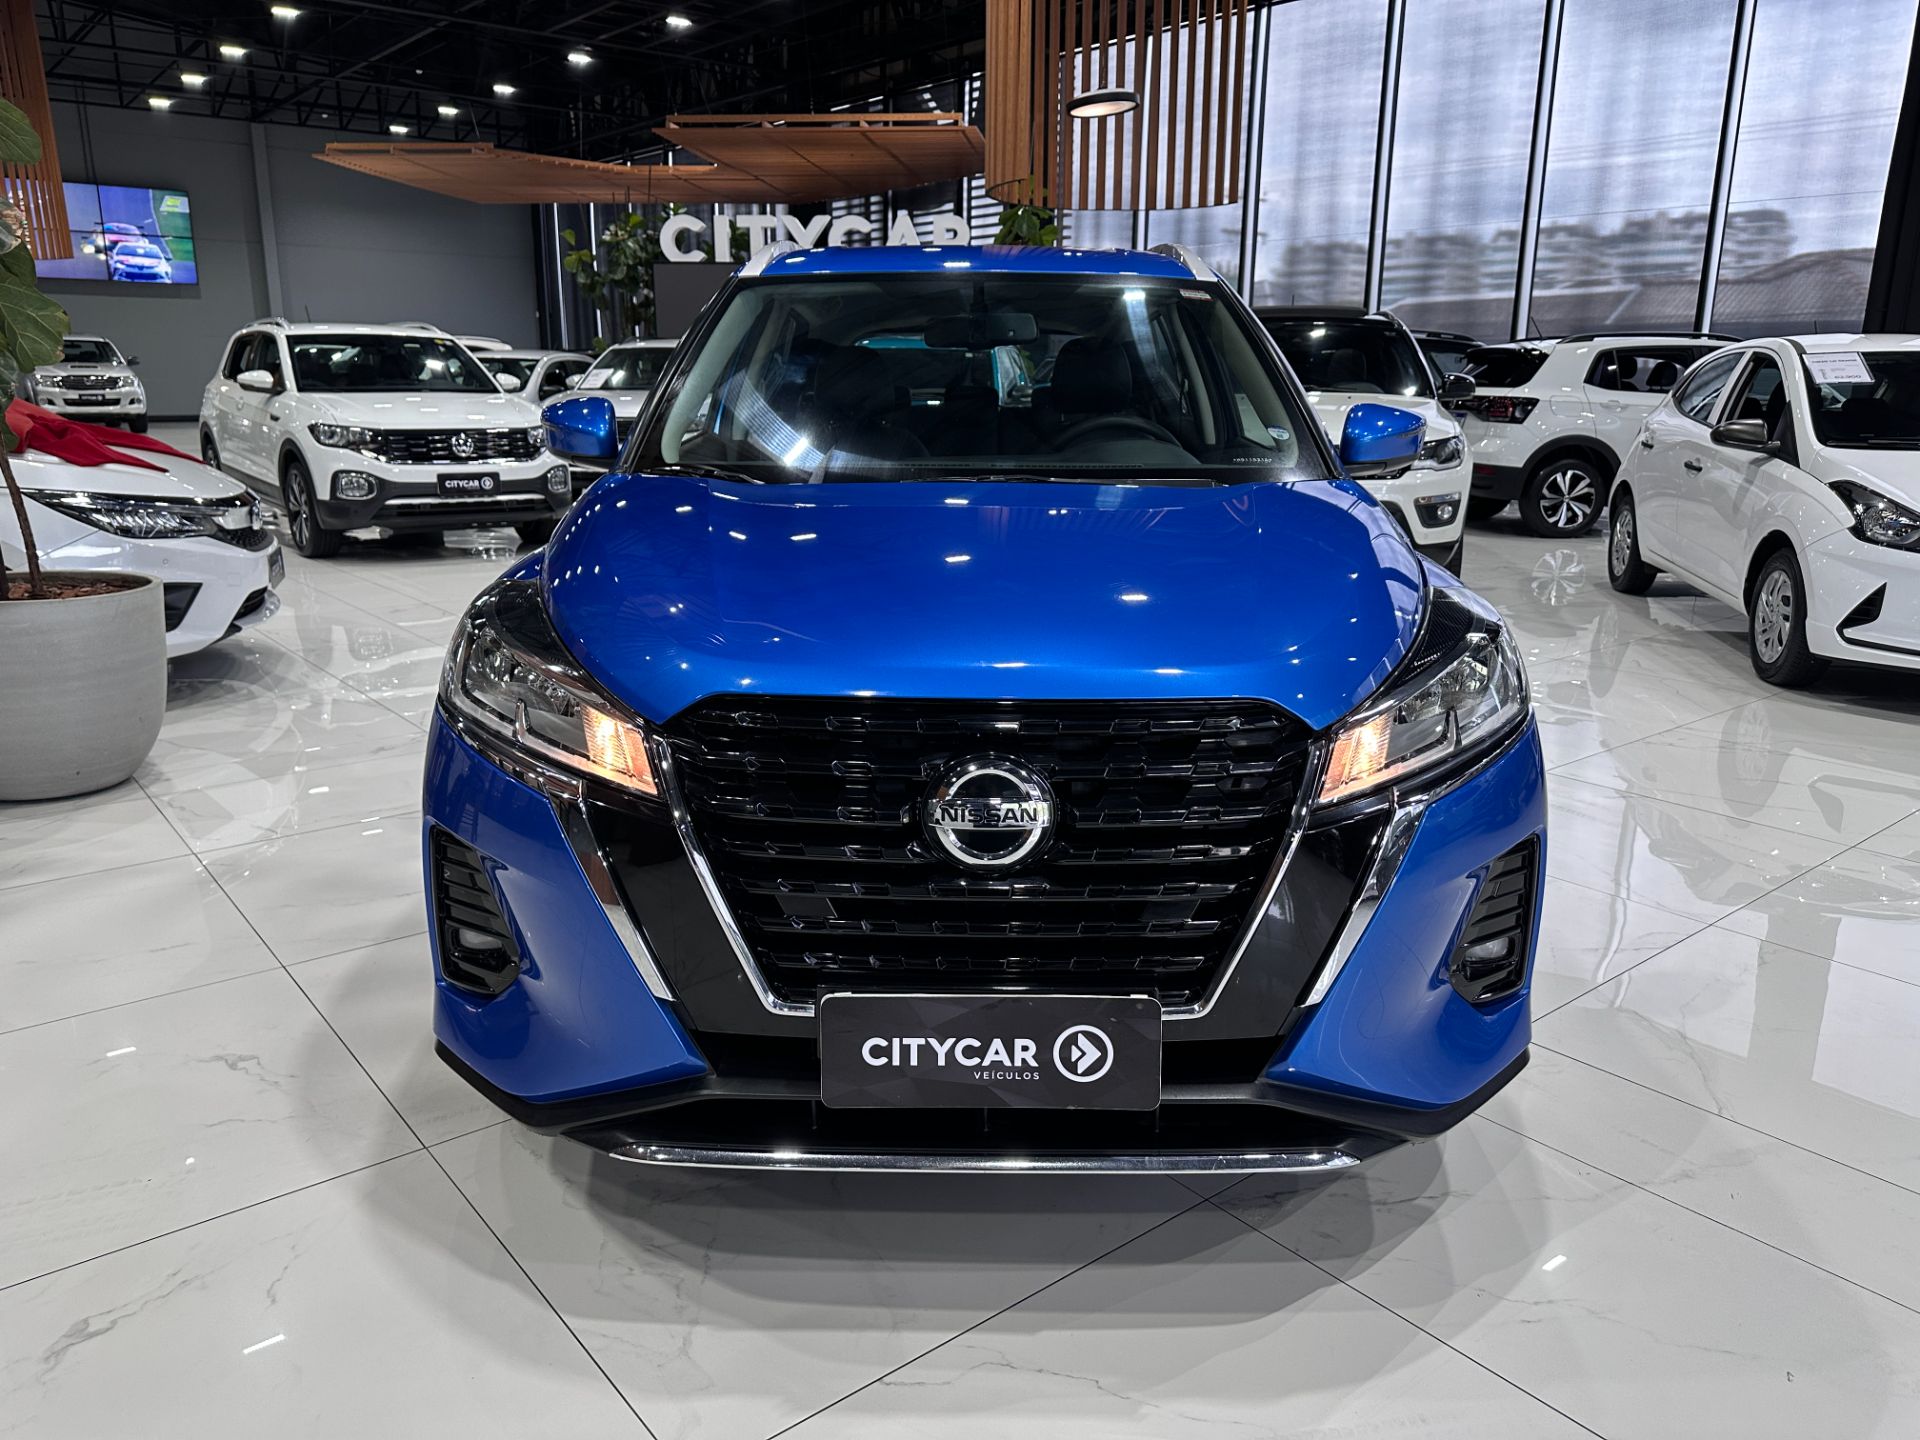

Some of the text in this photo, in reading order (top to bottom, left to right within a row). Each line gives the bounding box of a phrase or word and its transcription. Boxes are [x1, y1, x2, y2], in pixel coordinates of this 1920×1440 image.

[659, 213, 971, 263] CITYCAR
[445, 480, 479, 488] CITYCAR
[940, 806, 1038, 824] NISSAN
[861, 1037, 1039, 1067] CITYCAR
[973, 1069, 1040, 1081] VEÍCULOS
